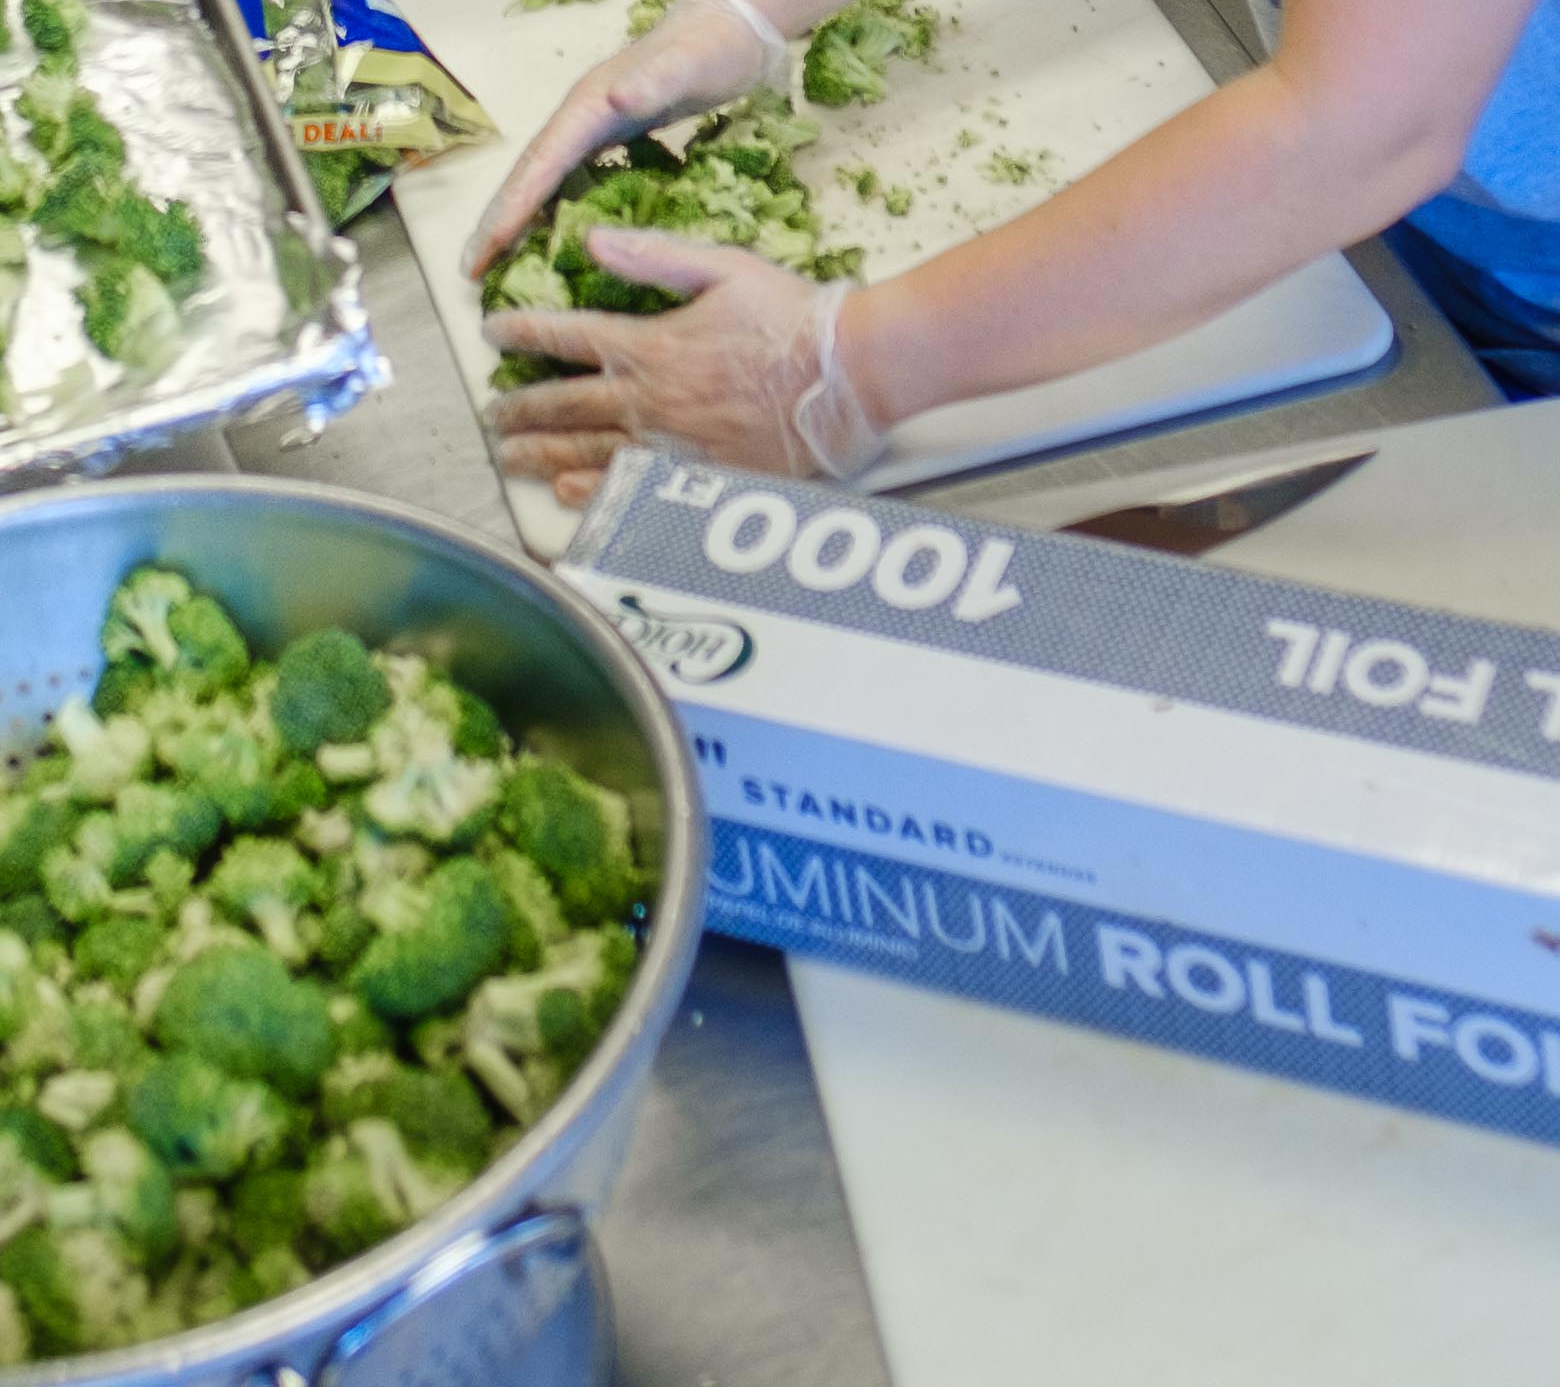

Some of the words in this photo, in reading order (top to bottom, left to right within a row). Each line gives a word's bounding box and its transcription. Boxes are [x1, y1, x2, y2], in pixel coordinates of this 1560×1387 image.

[655, 464, 721, 509] FT
[703, 490, 1024, 623] 1000
[1266, 617, 1496, 726] FOIL
[741, 775, 997, 861] STANDARD
[707, 834, 1071, 978] UMINUM
[1096, 922, 1366, 1052] ROLL
